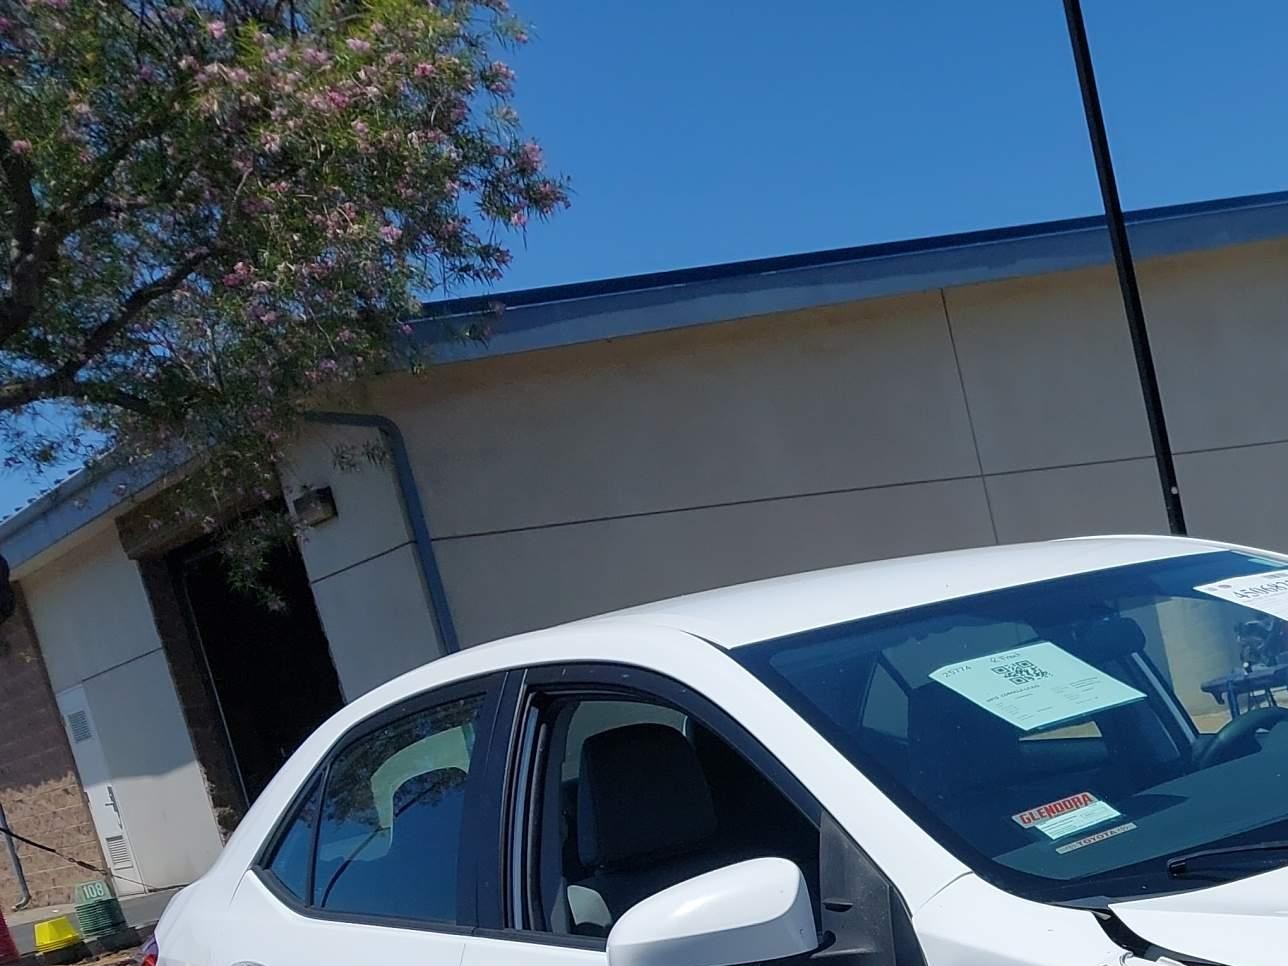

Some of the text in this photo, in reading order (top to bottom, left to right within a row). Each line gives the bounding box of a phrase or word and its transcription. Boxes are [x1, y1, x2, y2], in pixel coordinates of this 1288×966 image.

[1020, 793, 1094, 826] GLENDORA
[1080, 829, 1118, 846] TOYOTA
[83, 882, 104, 899] 108
